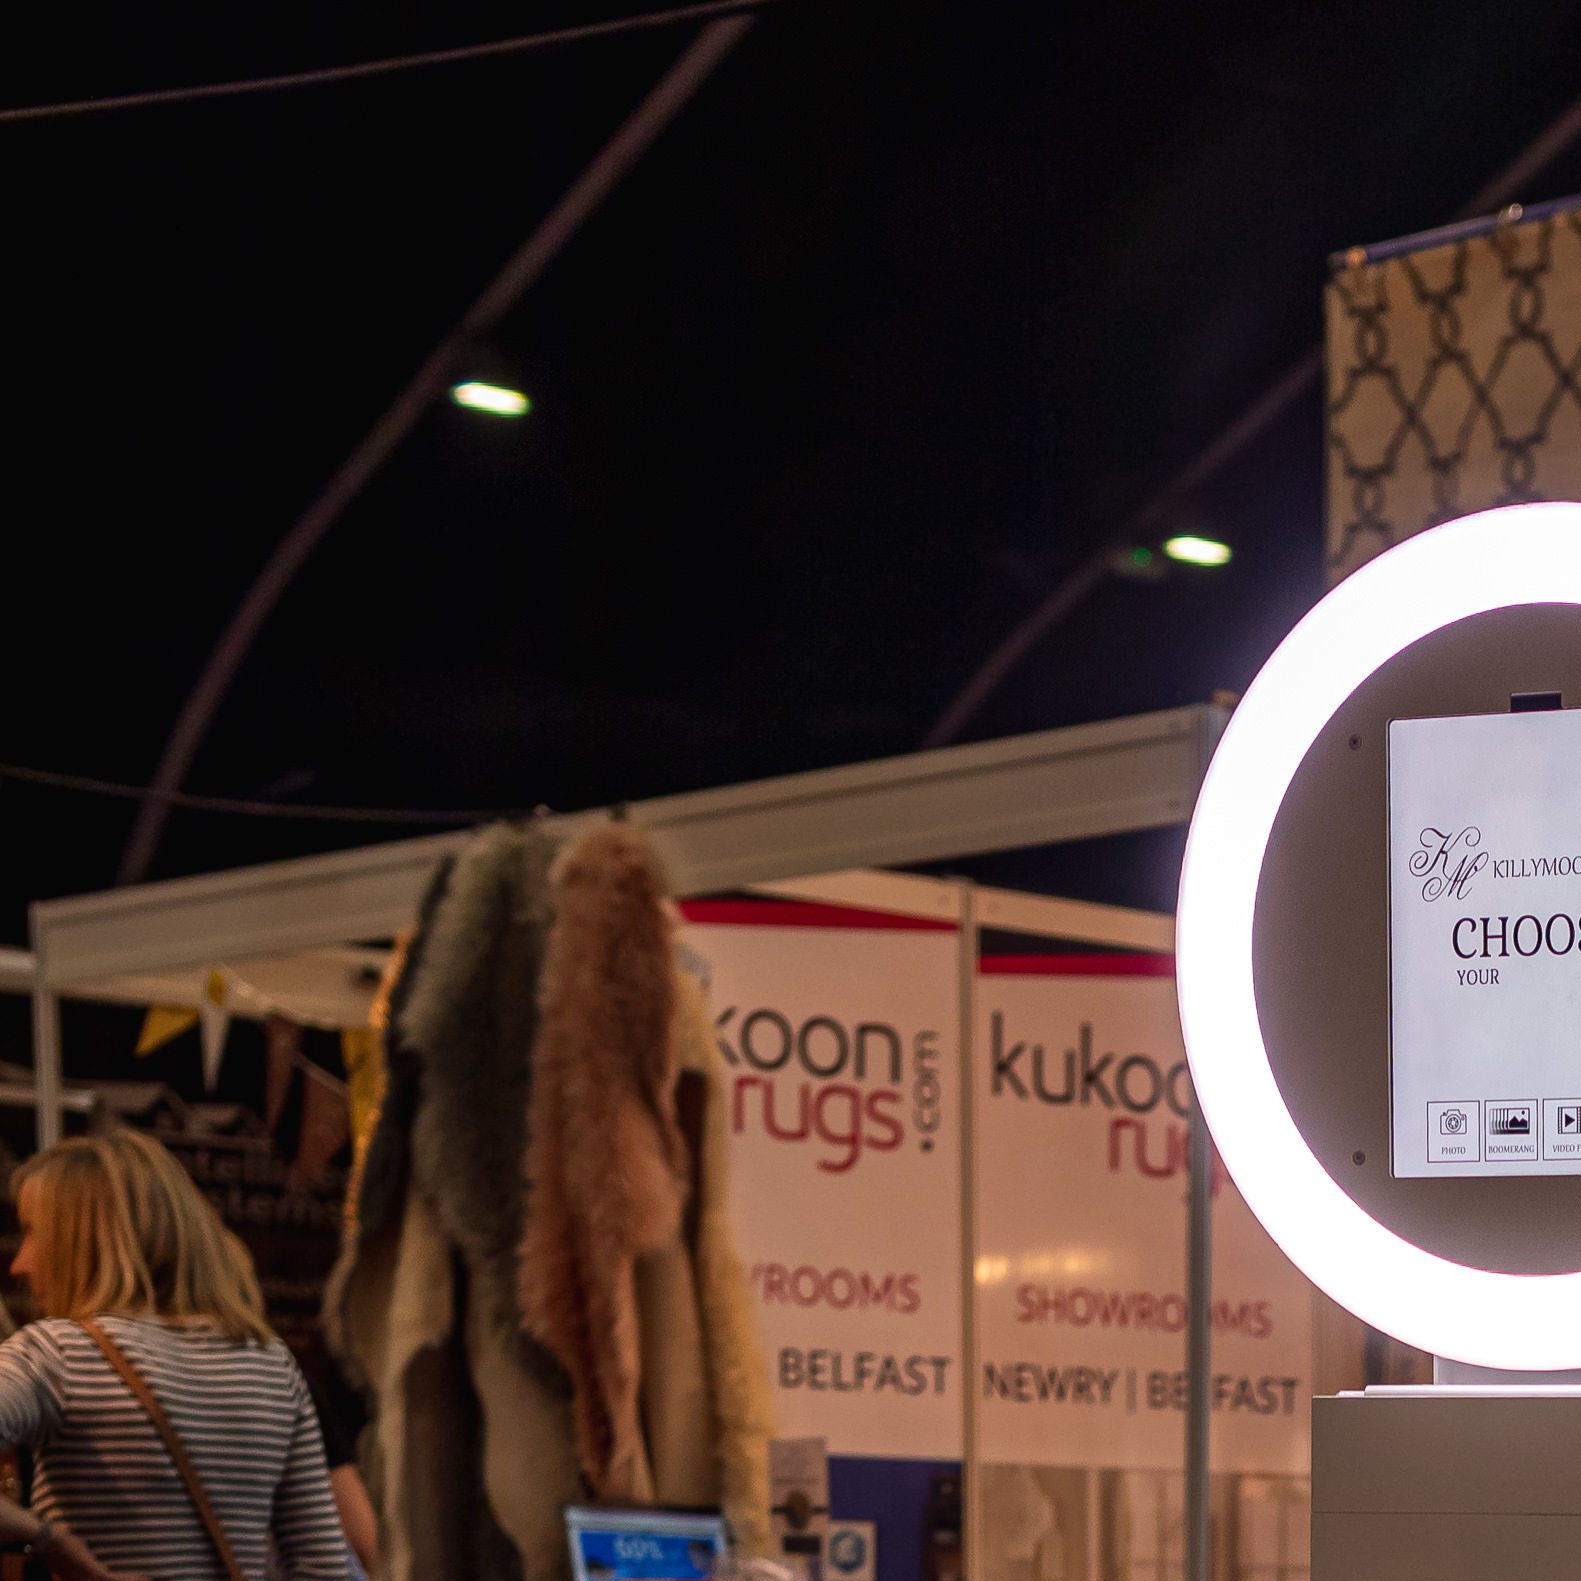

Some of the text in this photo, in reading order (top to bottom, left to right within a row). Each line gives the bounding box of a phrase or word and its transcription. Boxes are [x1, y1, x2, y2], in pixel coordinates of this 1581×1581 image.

[1457, 968, 1499, 986] YOUR
[732, 1075, 904, 1173] rugs
[1552, 1144, 1575, 1153] VIDEO
[1441, 1146, 1466, 1155] PHOTO
[1488, 1145, 1535, 1154] BOOMERANG
[751, 1263, 921, 1314] ROOMS
[1015, 1283, 1275, 1340] SHOWROMS
[779, 1347, 951, 1397] BELFAST
[983, 1362, 1119, 1404] NEWRY
[1146, 1370, 1299, 1416] BEFAST
